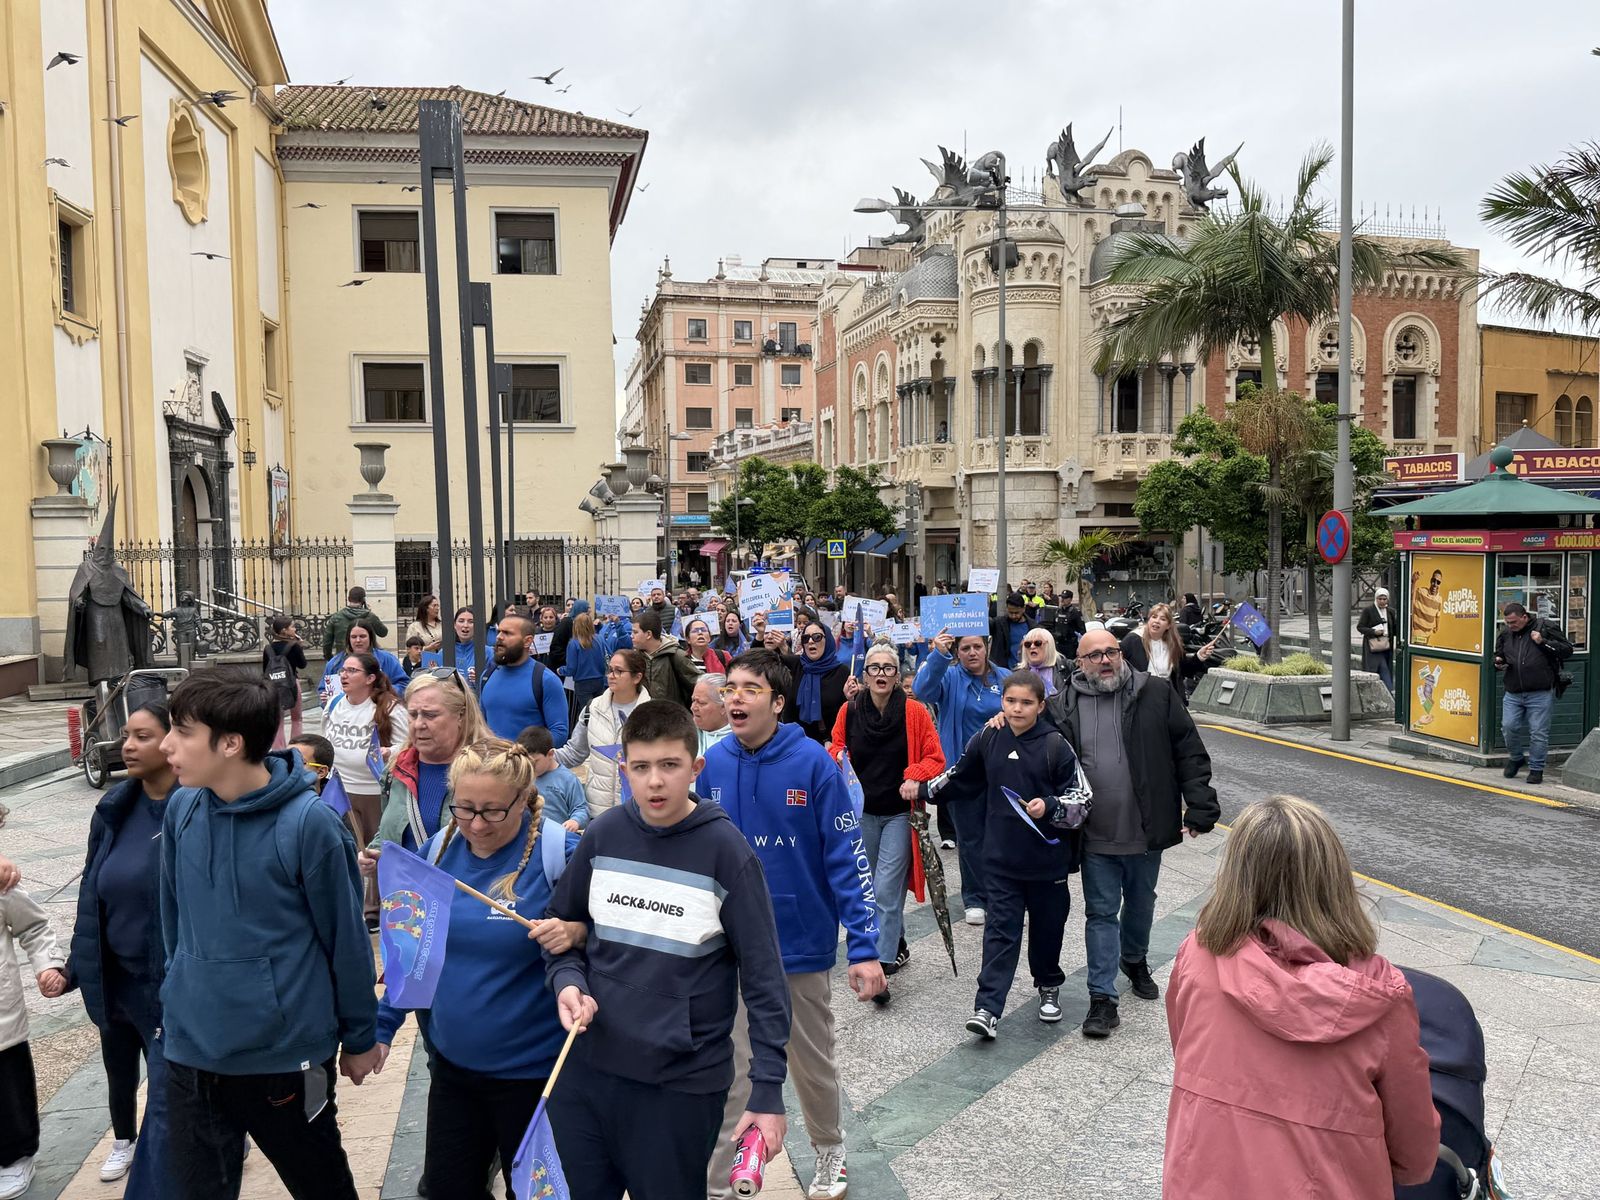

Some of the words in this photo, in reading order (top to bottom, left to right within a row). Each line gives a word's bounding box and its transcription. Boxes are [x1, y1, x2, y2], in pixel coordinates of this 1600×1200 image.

[1404, 461, 1452, 474] TABACOS
[1448, 588, 1472, 601] AHORA
[1443, 600, 1478, 614] SIEMPRE
[269, 671, 286, 680] VANS
[1444, 688, 1467, 700] AHORA
[1440, 698, 1472, 711] SIEMPRE
[834, 810, 860, 831] OSL
[744, 835, 797, 847] WAY
[850, 837, 880, 934] NORWAY
[607, 893, 684, 917] JACK&JONES
